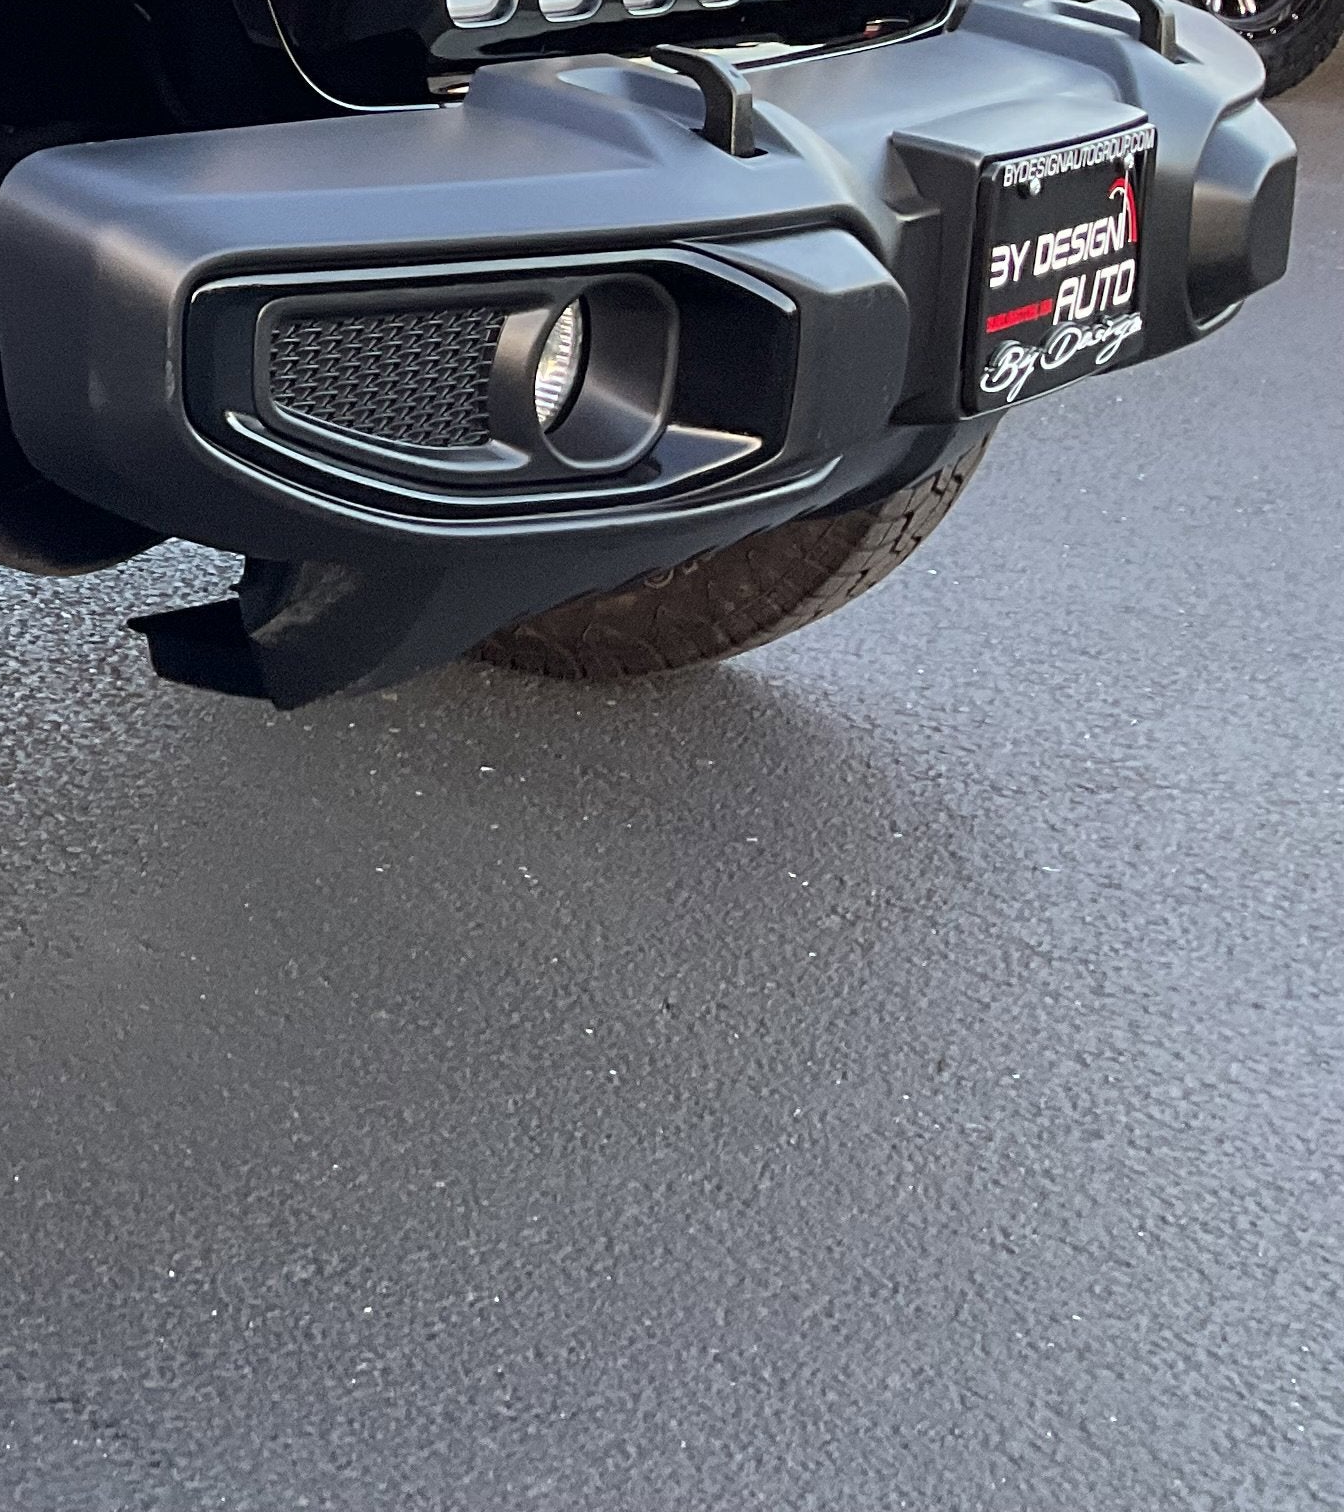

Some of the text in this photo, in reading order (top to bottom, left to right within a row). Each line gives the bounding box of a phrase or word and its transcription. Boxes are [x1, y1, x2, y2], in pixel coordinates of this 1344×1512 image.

[1003, 128, 1155, 187] BYDESIGNAUTOGROUP.COM
[989, 213, 1126, 287] BY DESIGN
[1053, 259, 1135, 325] AUTO
[980, 344, 1039, 402] By
